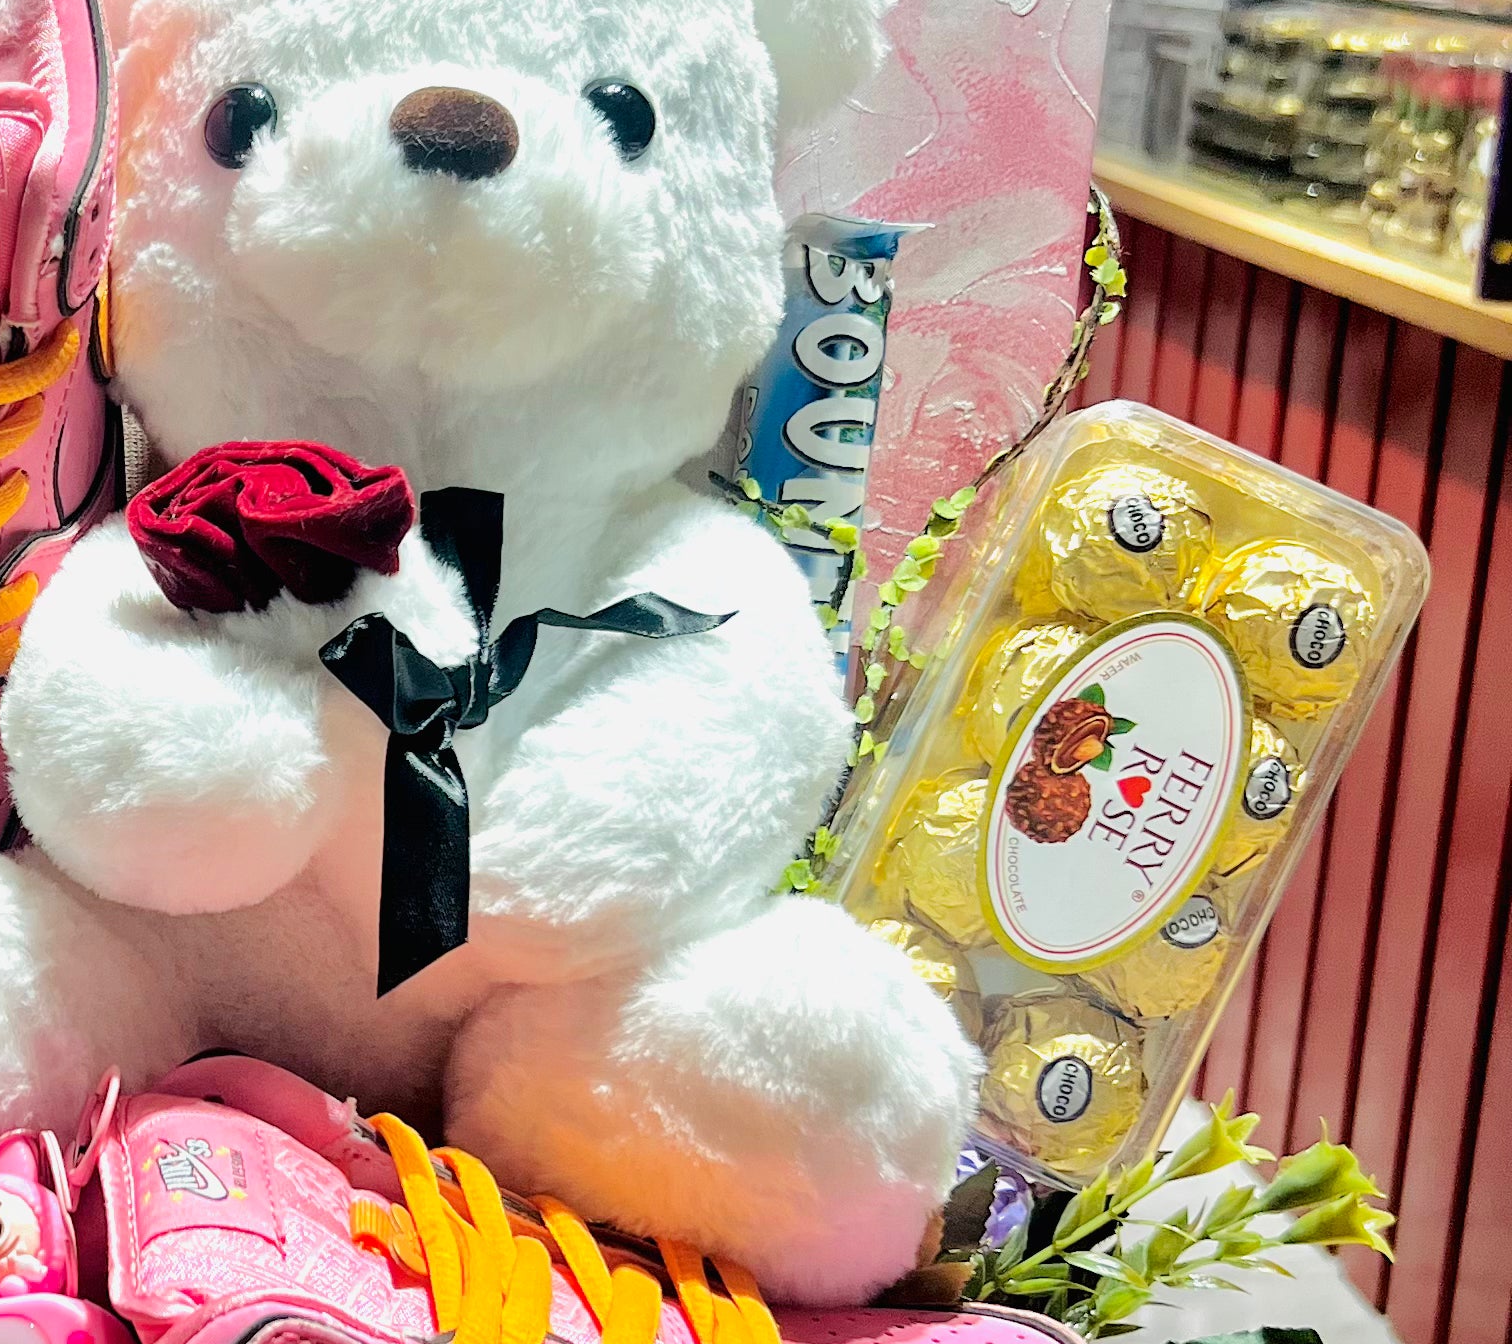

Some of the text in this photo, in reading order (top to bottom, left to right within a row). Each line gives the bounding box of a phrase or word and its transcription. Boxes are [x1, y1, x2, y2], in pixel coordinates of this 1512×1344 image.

[1307, 611, 1330, 661] CHOCO
[1099, 652, 1143, 681] WAFER
[1255, 762, 1280, 812] CHOCO
[1007, 837, 1027, 914] CHOCOLATE
[1169, 906, 1216, 935] CHOCO
[1053, 1063, 1079, 1116] CHOCO
